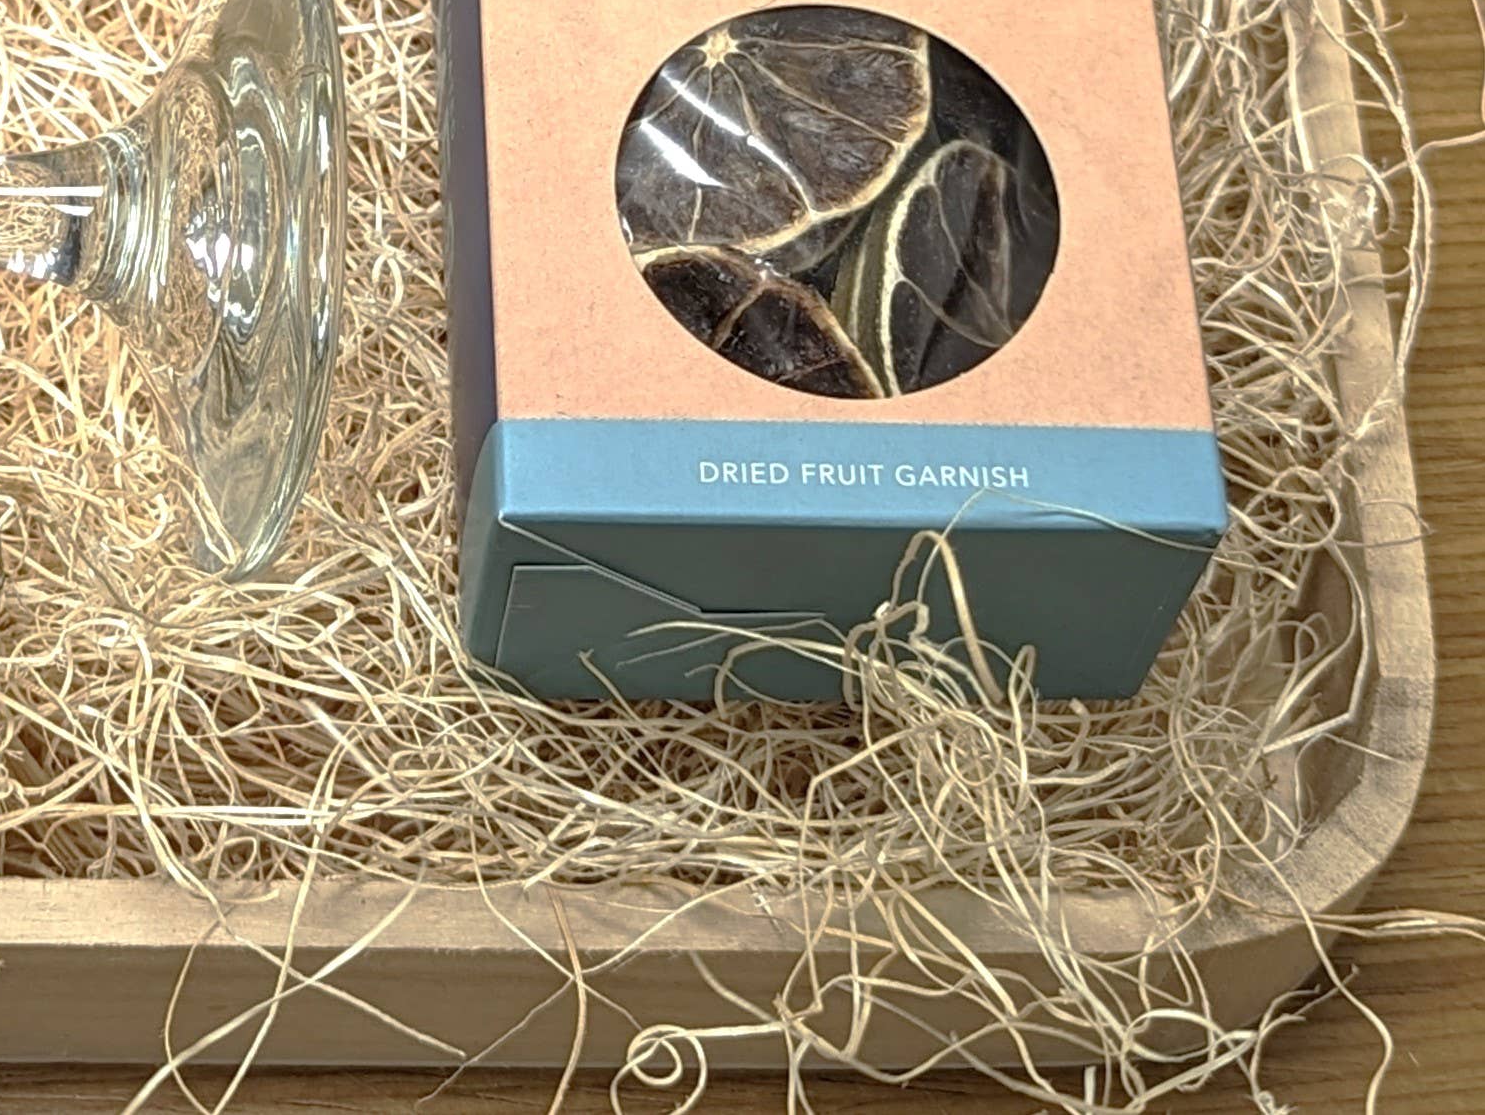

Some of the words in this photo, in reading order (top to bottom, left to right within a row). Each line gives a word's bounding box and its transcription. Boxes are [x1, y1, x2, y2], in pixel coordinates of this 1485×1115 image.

[699, 460, 789, 485] DRIED
[800, 463, 884, 487] FRUIT
[894, 463, 1030, 488] GARNISH
